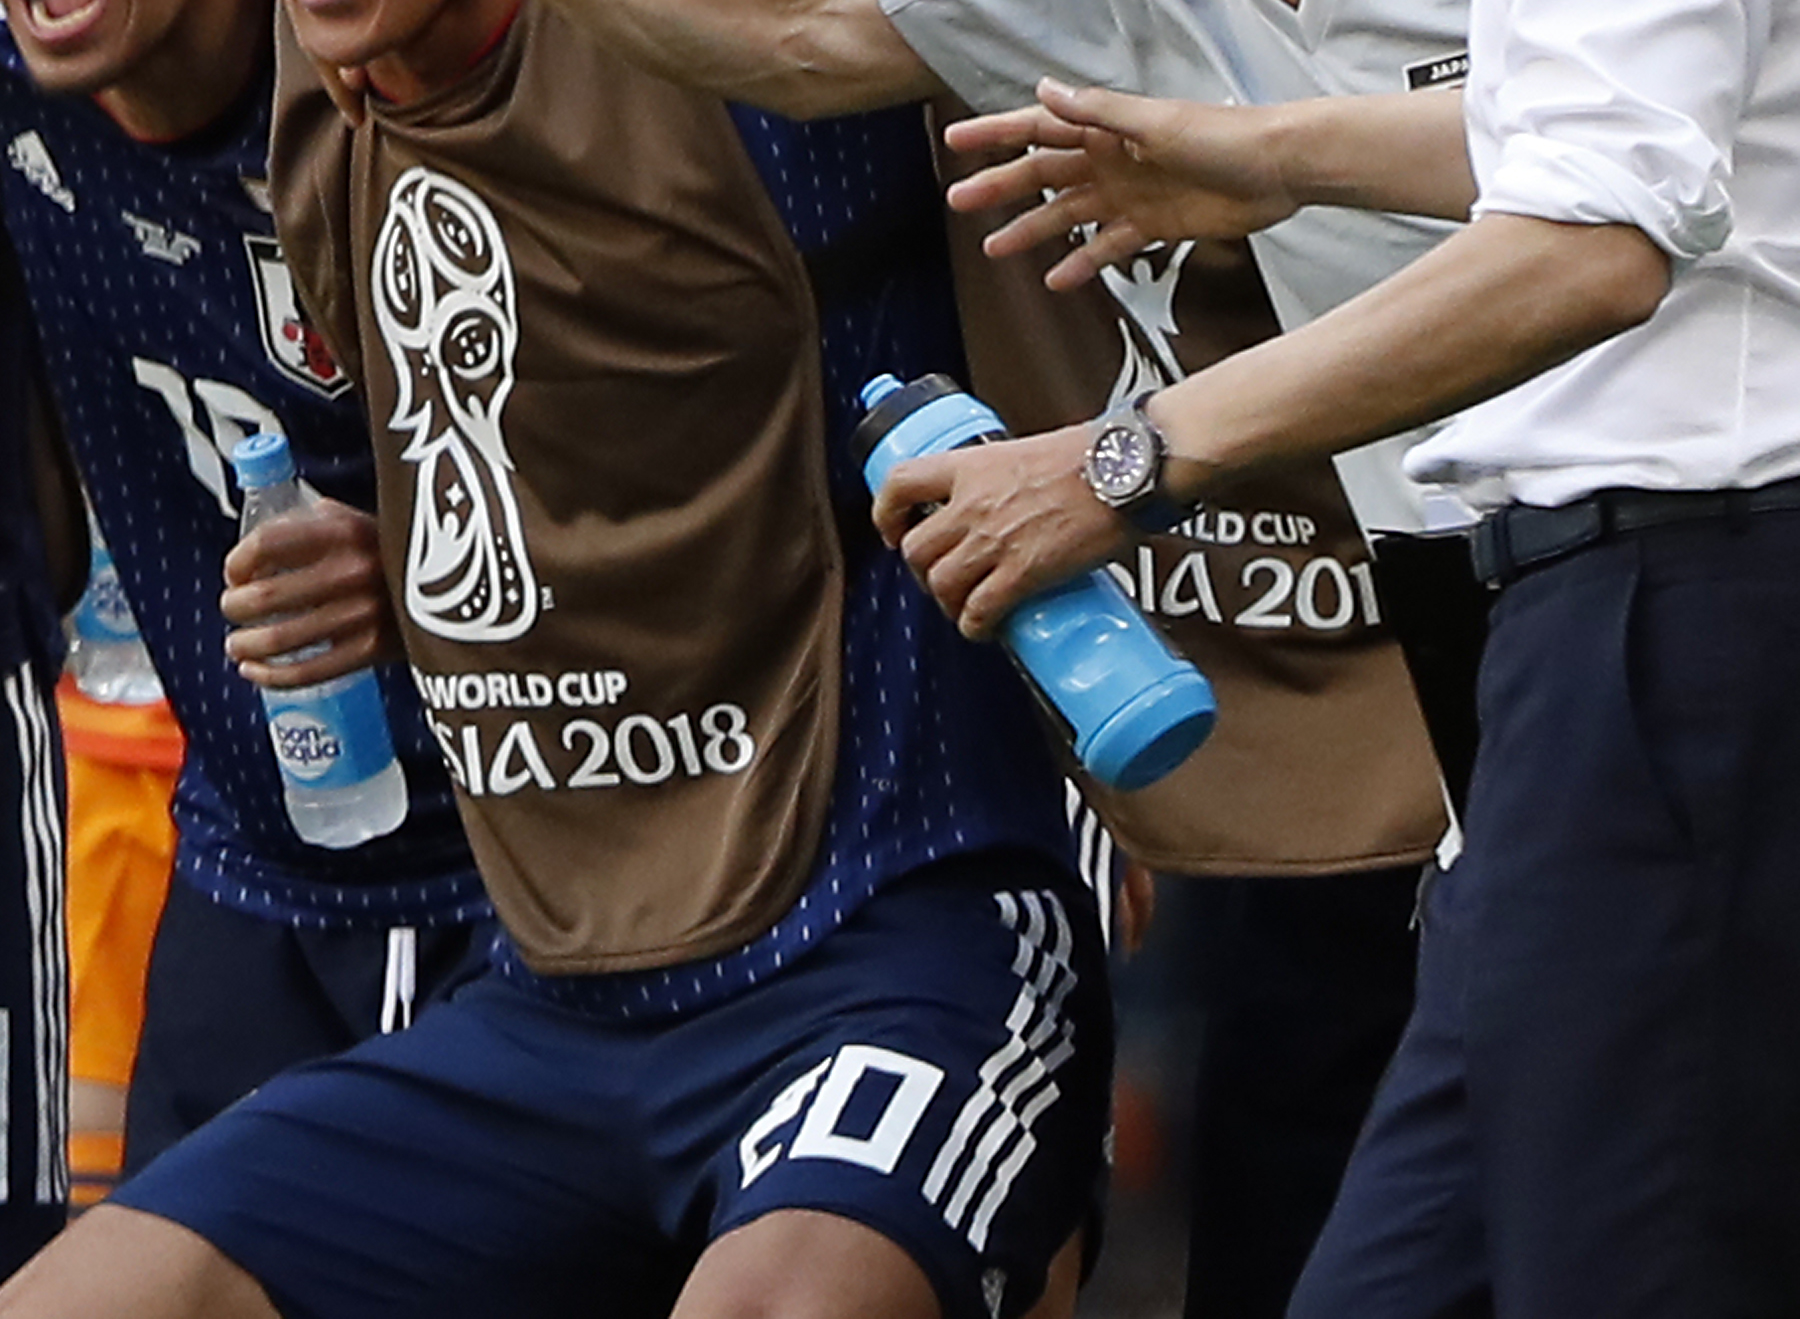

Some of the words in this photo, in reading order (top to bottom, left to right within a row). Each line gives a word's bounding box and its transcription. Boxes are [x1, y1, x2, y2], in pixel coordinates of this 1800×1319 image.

[1251, 511, 1317, 545] CUP
[425, 673, 554, 710] WORLD
[558, 671, 628, 707] CUP
[562, 702, 756, 789] 2018
[740, 1043, 946, 1190] 20
